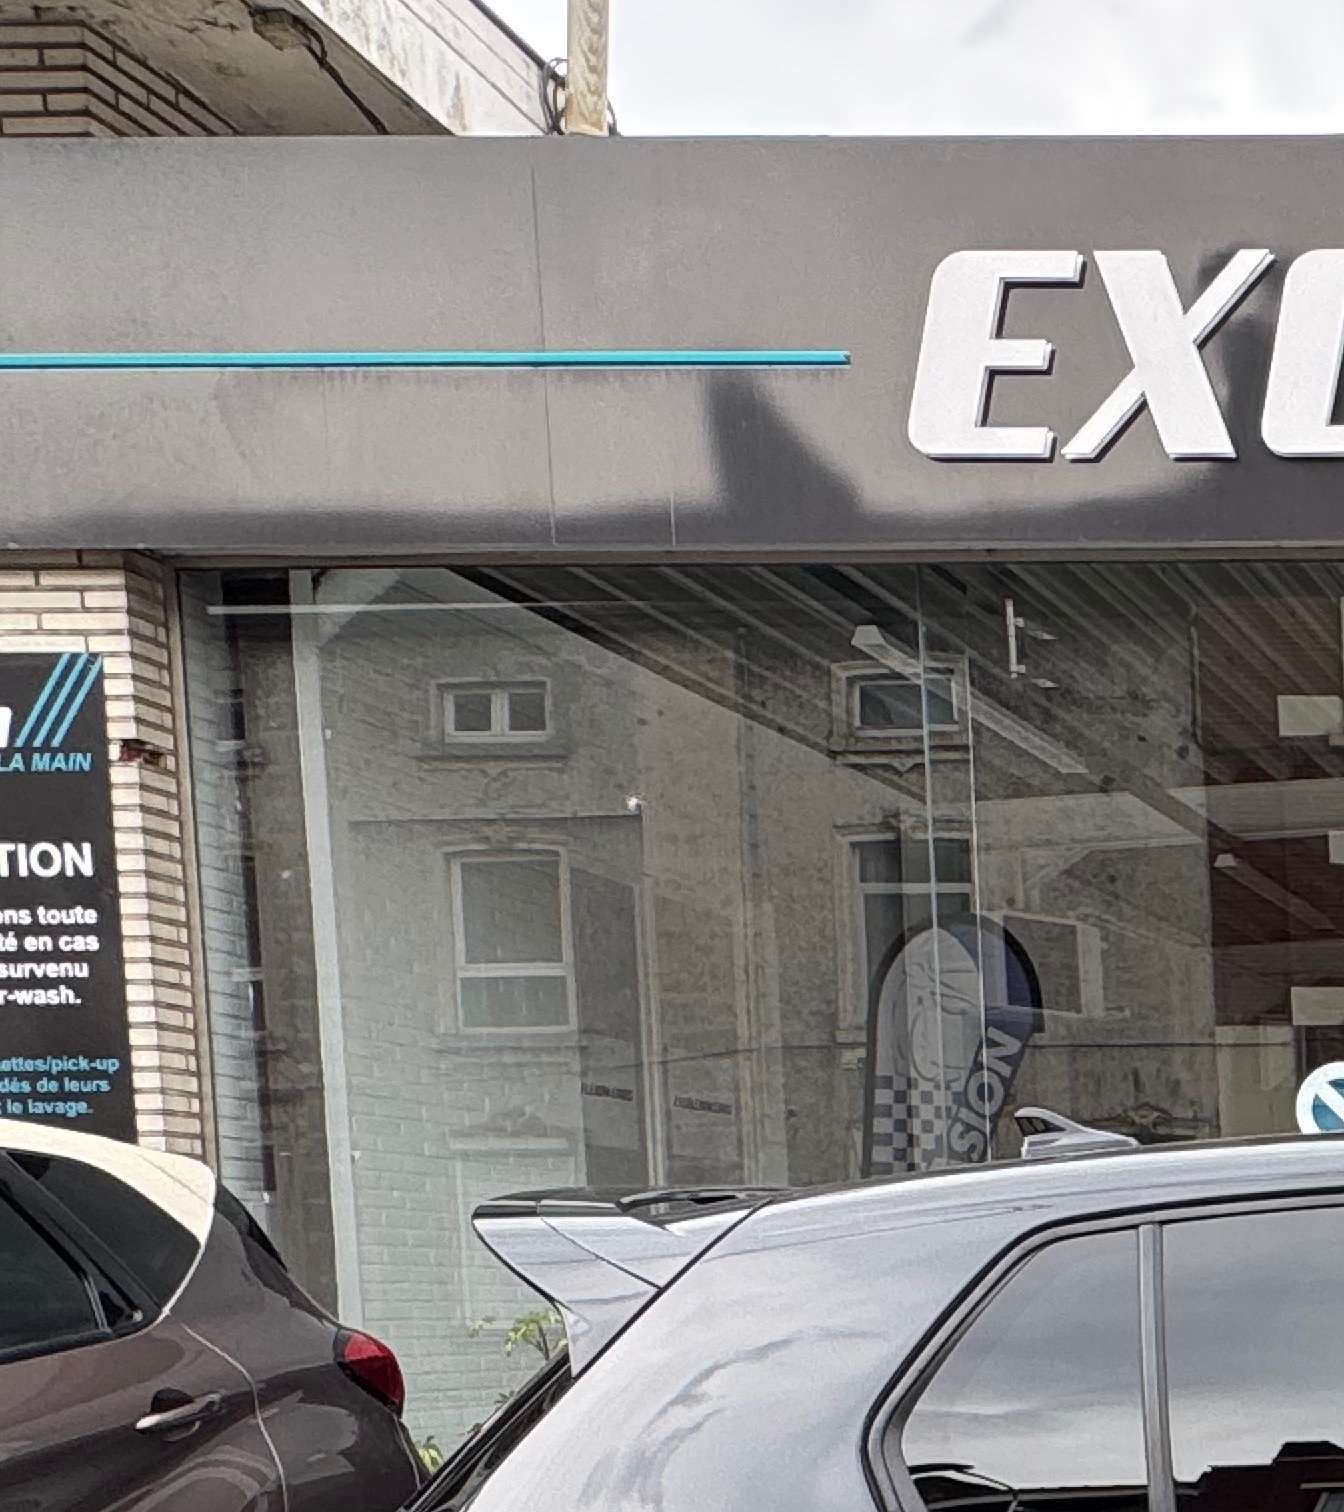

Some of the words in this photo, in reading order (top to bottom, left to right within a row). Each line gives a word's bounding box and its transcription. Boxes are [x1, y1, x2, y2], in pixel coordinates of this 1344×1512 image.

[31, 752, 92, 772] MAIN
[0, 843, 94, 877] TION
[0, 909, 31, 925] ns
[37, 905, 98, 925] toute
[24, 936, 53, 951] en
[59, 935, 100, 951] cas
[0, 962, 89, 979] survenu
[36, 1077, 59, 1093] de
[63, 1077, 112, 1093] leurs
